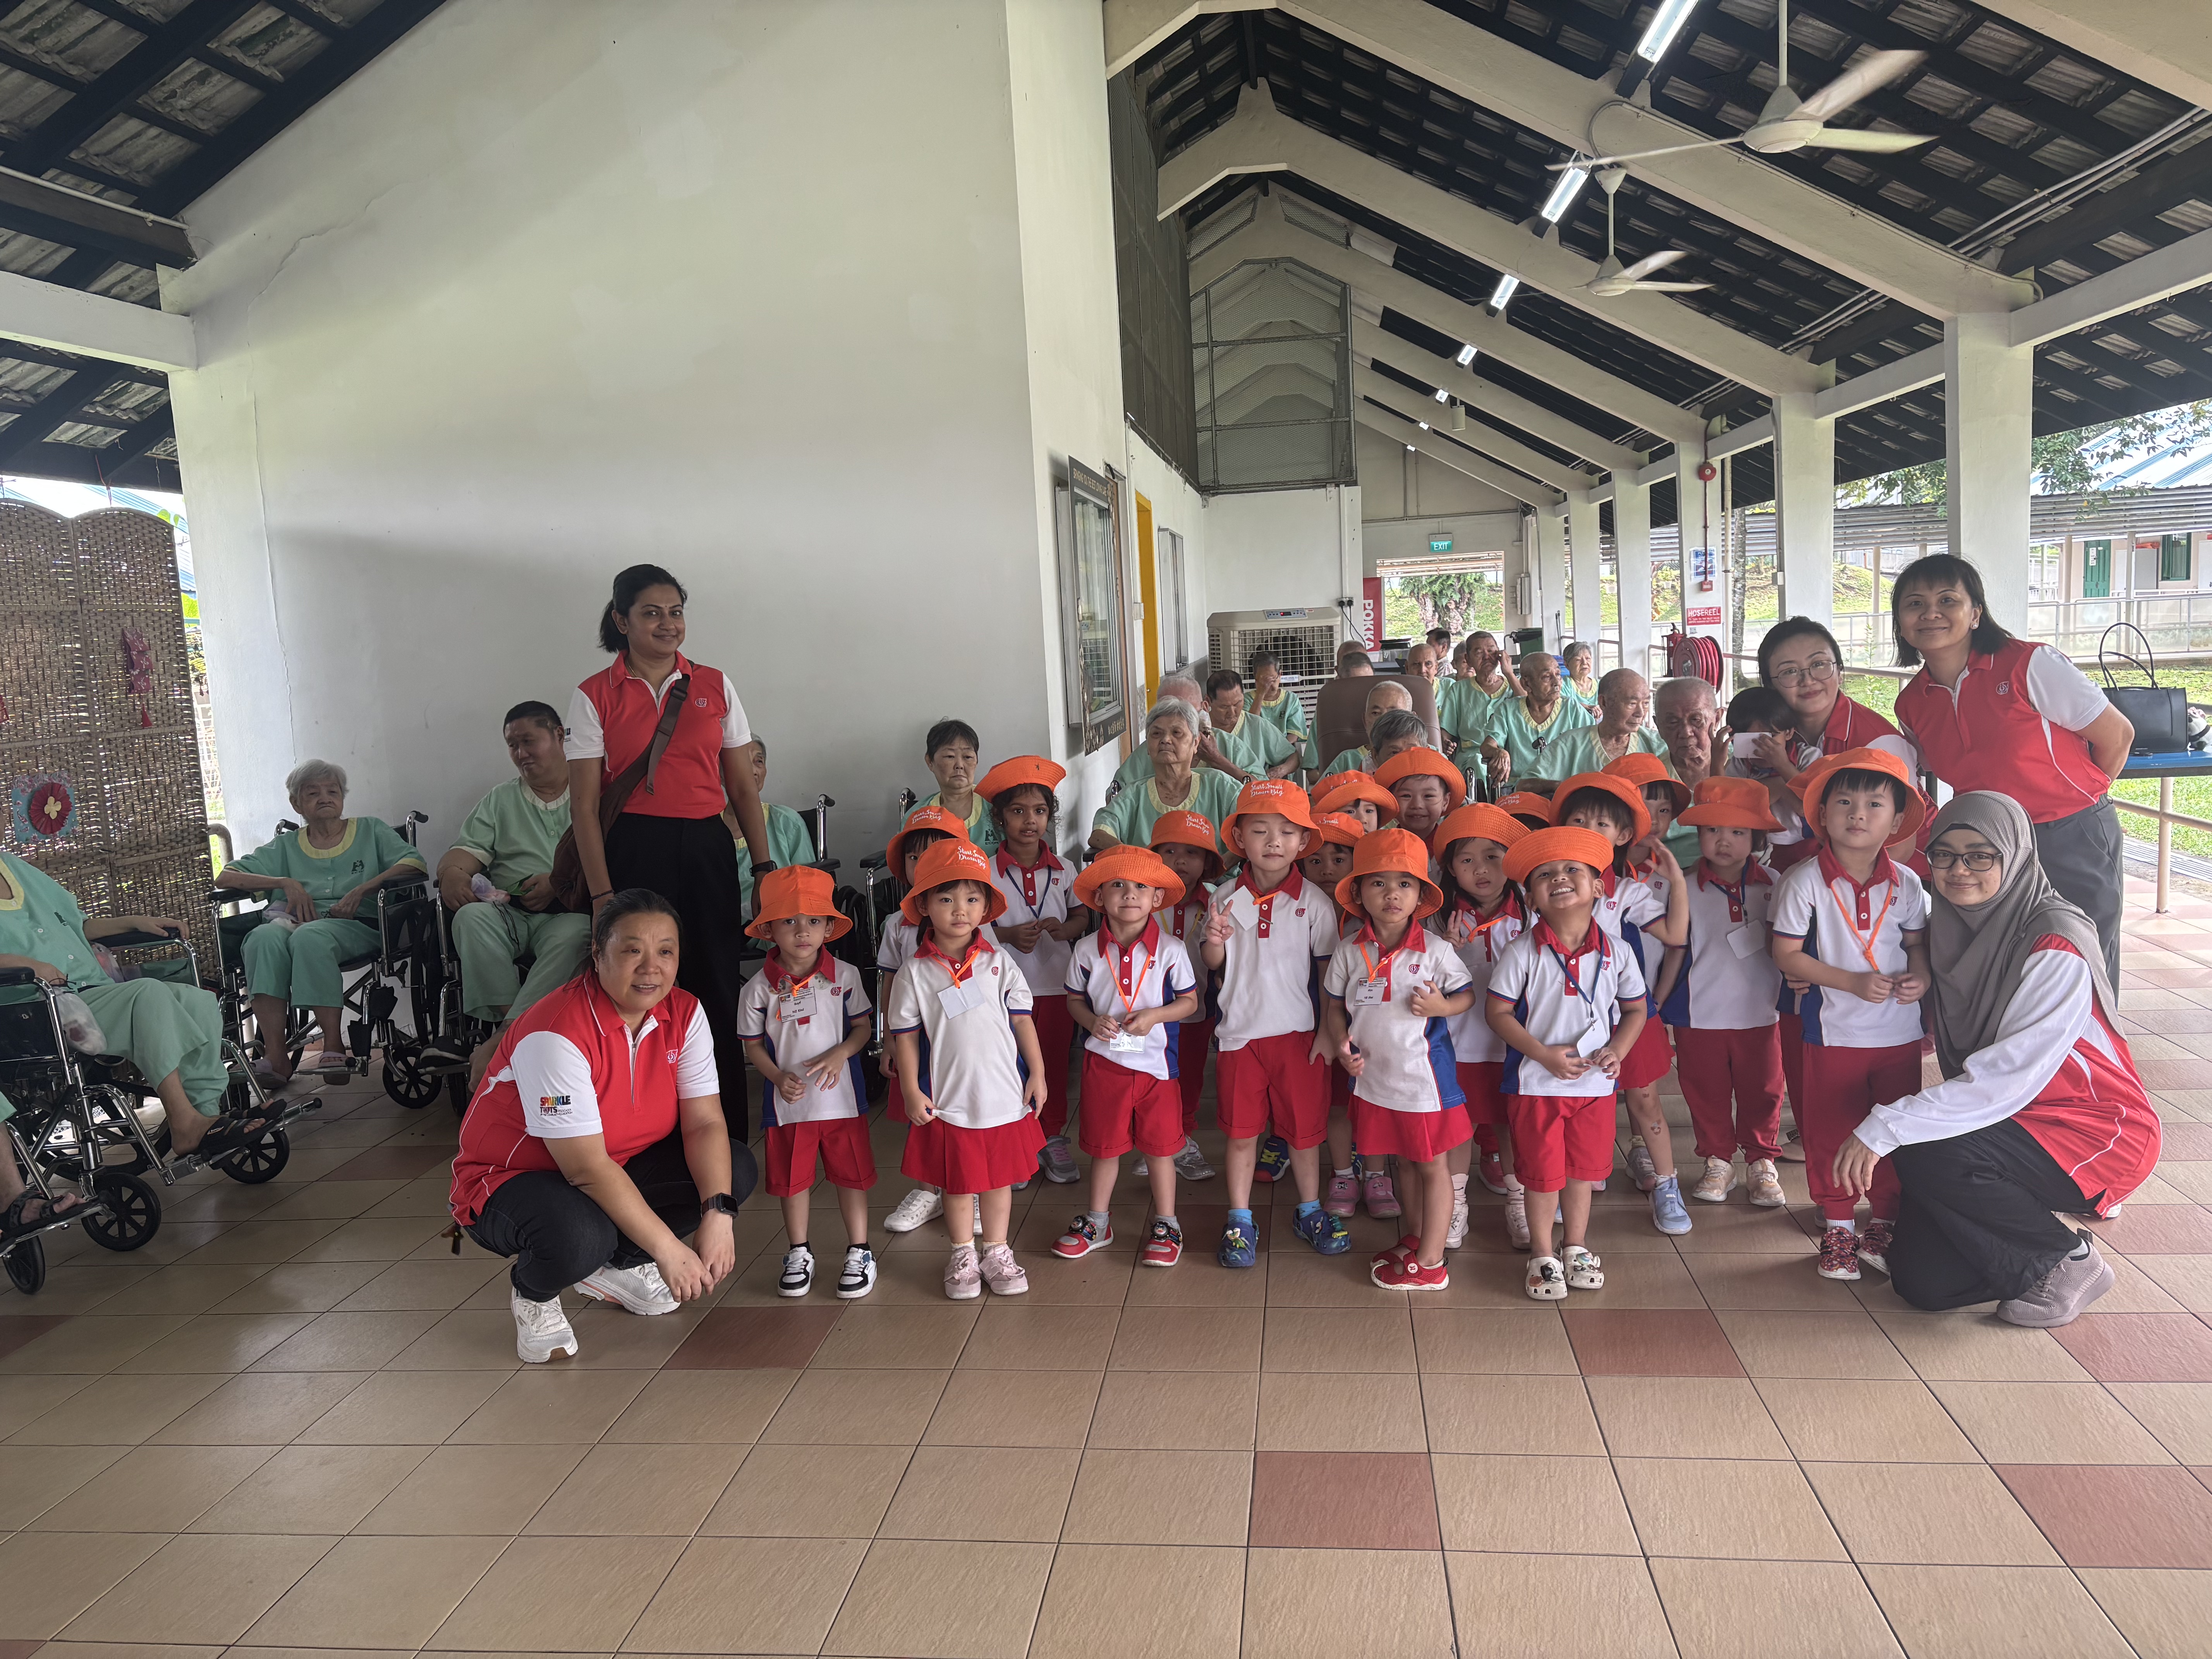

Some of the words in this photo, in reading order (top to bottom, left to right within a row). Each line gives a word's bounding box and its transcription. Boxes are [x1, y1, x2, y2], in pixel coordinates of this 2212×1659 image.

[1688, 608, 1720, 617] HOSEREEL
[1363, 599, 1374, 650] POKKA
[540, 1095, 571, 1106] SPARKLE
